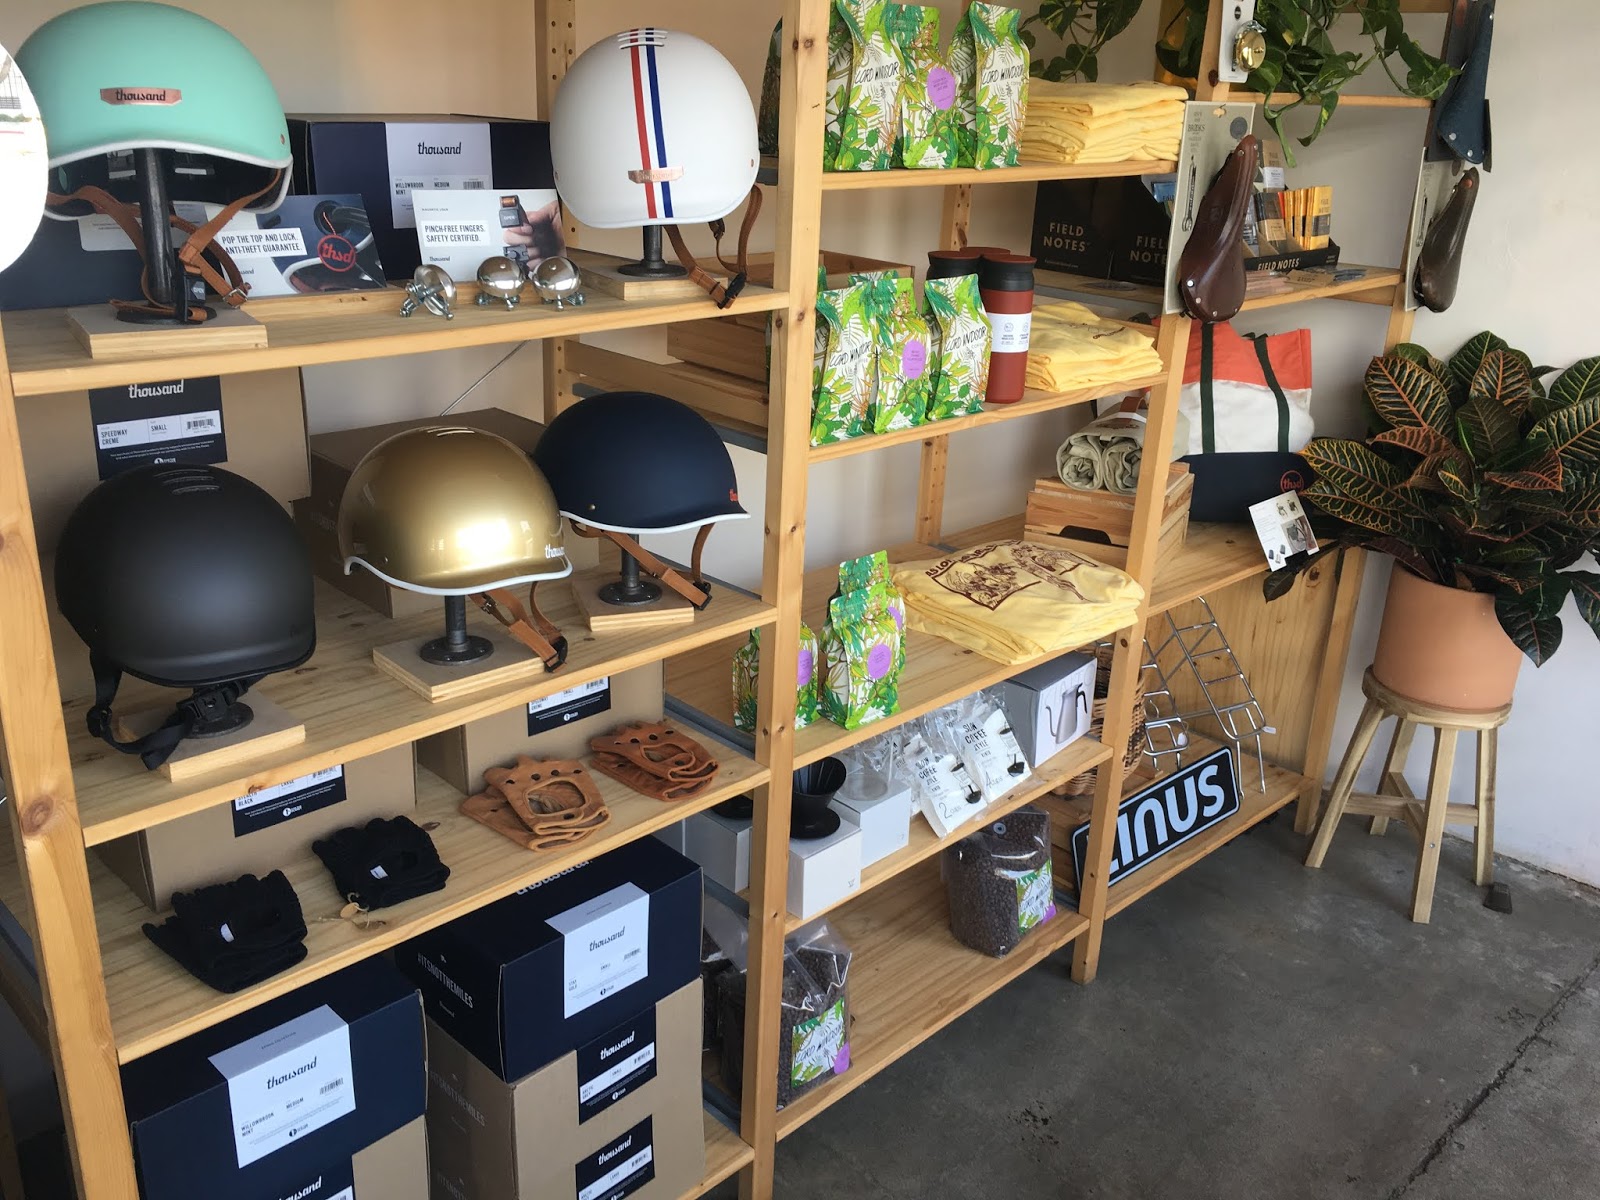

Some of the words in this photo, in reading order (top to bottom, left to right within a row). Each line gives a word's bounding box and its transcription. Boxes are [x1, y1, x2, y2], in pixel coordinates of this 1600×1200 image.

[855, 68, 874, 85] LORD
[875, 61, 899, 79] WINDSOR
[982, 68, 1001, 85] LORD
[115, 89, 166, 102] thousand
[417, 142, 462, 155] thousand
[395, 181, 424, 189] WILLOWBROOK
[424, 224, 460, 233] PINCH-FREE
[459, 224, 486, 233] FINGERS.
[1049, 222, 1084, 237] FIELD
[221, 235, 237, 244] POP
[237, 234, 250, 243] THE
[250, 234, 264, 243] TOP
[265, 233, 279, 242] AND
[280, 232, 299, 241] LOCK.
[426, 234, 449, 243] SAFETY
[449, 233, 481, 242] CERTIFIED.
[1043, 236, 1087, 252] NOTES
[1136, 235, 1169, 250] FIEL
[262, 243, 303, 253] GUARANTEE.
[321, 242, 354, 264] thsd
[1130, 250, 1168, 265] NOTE
[1257, 261, 1277, 271] FIELD
[1277, 257, 1300, 270] NOTES
[945, 335, 962, 352] LORD
[829, 352, 848, 368] LORD
[127, 379, 185, 399] thousand
[100, 428, 128, 439] SPEEDWAY
[150, 424, 167, 432] SMALL
[101, 437, 120, 446] CREME
[238, 798, 254, 807] BLACK
[588, 926, 627, 952] thousand
[600, 1030, 635, 1060] thousand
[266, 1056, 318, 1090] thousand
[285, 1097, 304, 1110] MEDIUM
[240, 1112, 275, 1132] WILLOWBROOK
[241, 1128, 254, 1138] MINT
[598, 1134, 632, 1166] thousand
